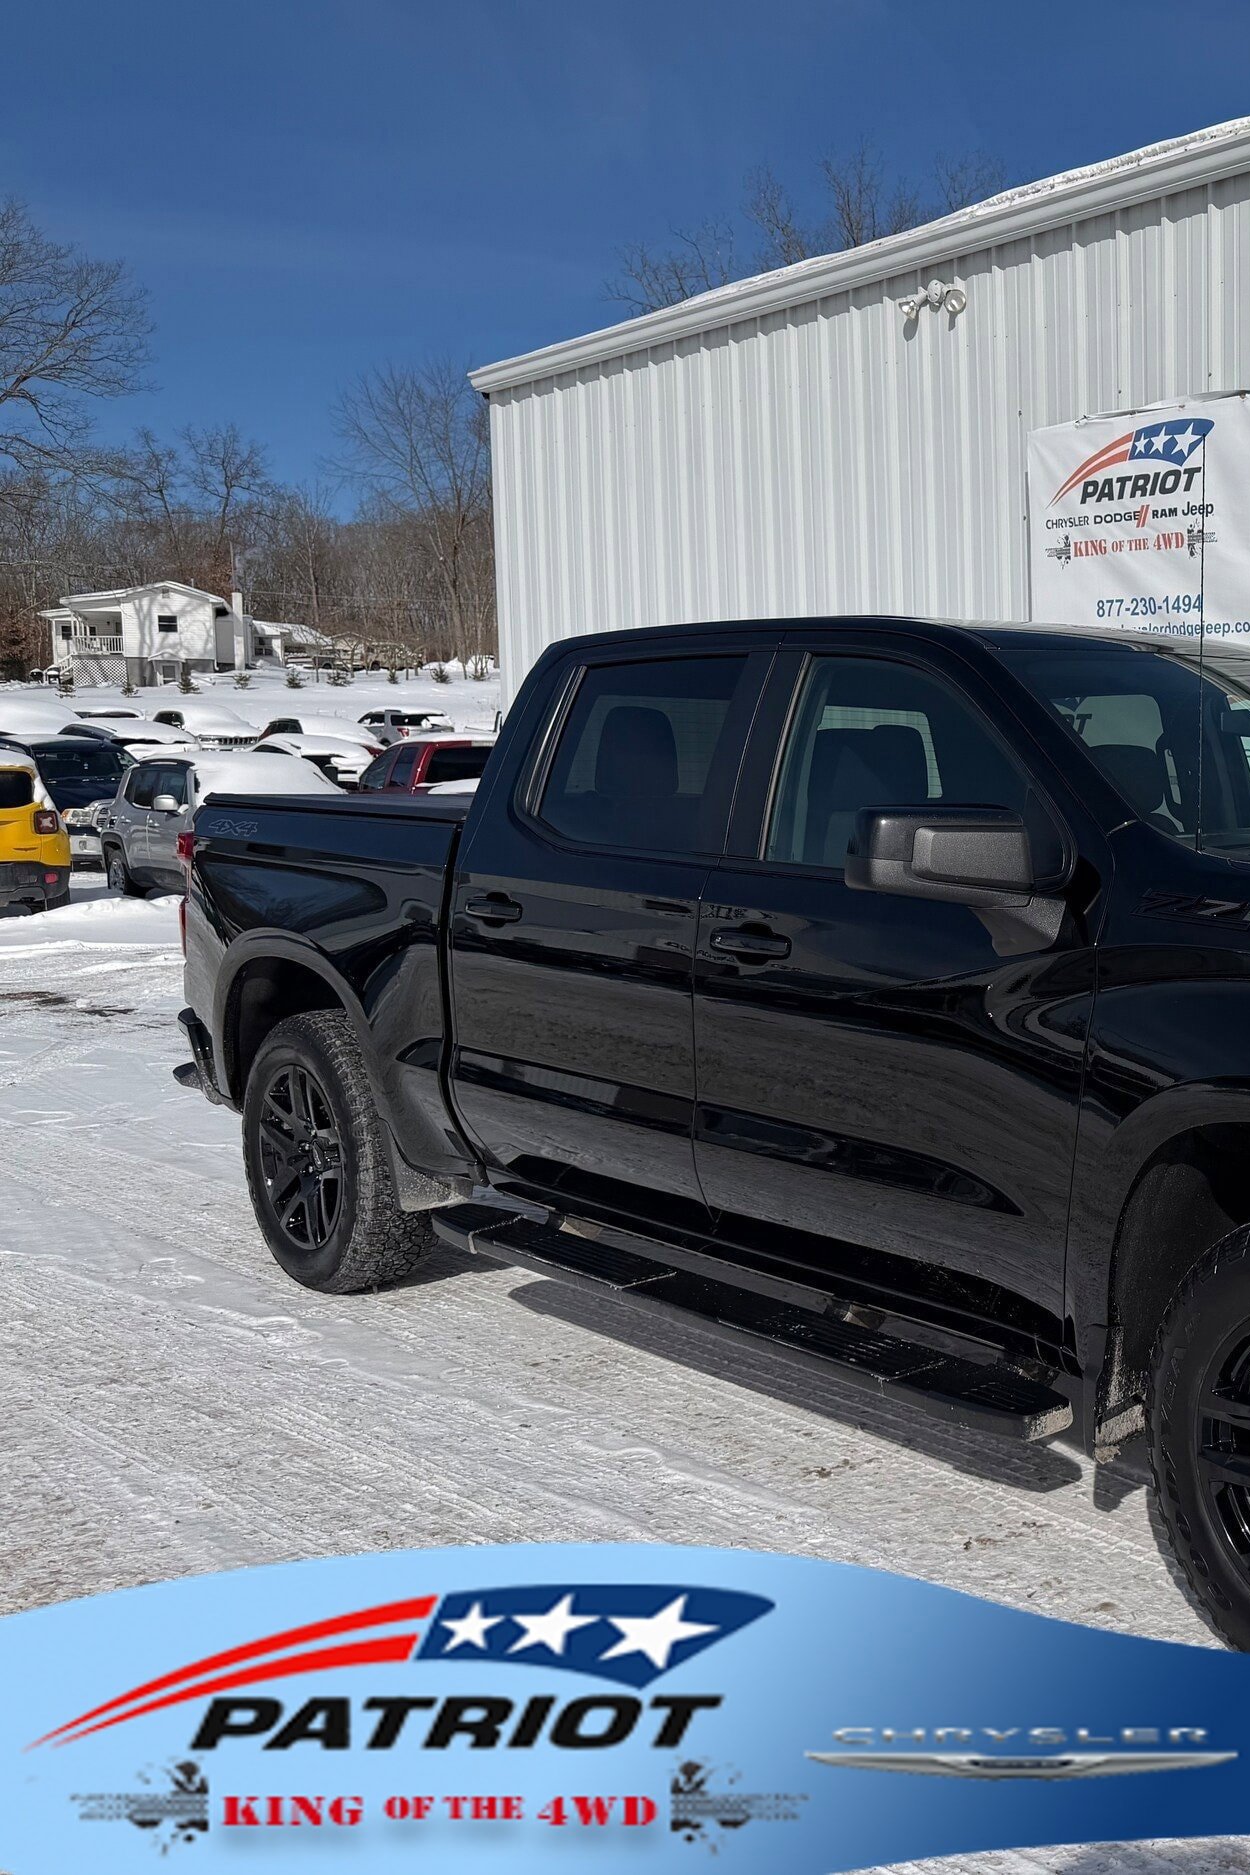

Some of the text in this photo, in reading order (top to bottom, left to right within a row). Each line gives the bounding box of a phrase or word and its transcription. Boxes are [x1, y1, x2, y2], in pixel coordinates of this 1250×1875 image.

[1080, 466, 1202, 504] PATRIOT
[1045, 501, 1214, 530] CHRYSLER DODGE RAM Jeep
[1073, 531, 1185, 558] KING OF THE 4WD
[1096, 594, 1202, 618] 877-230-1494
